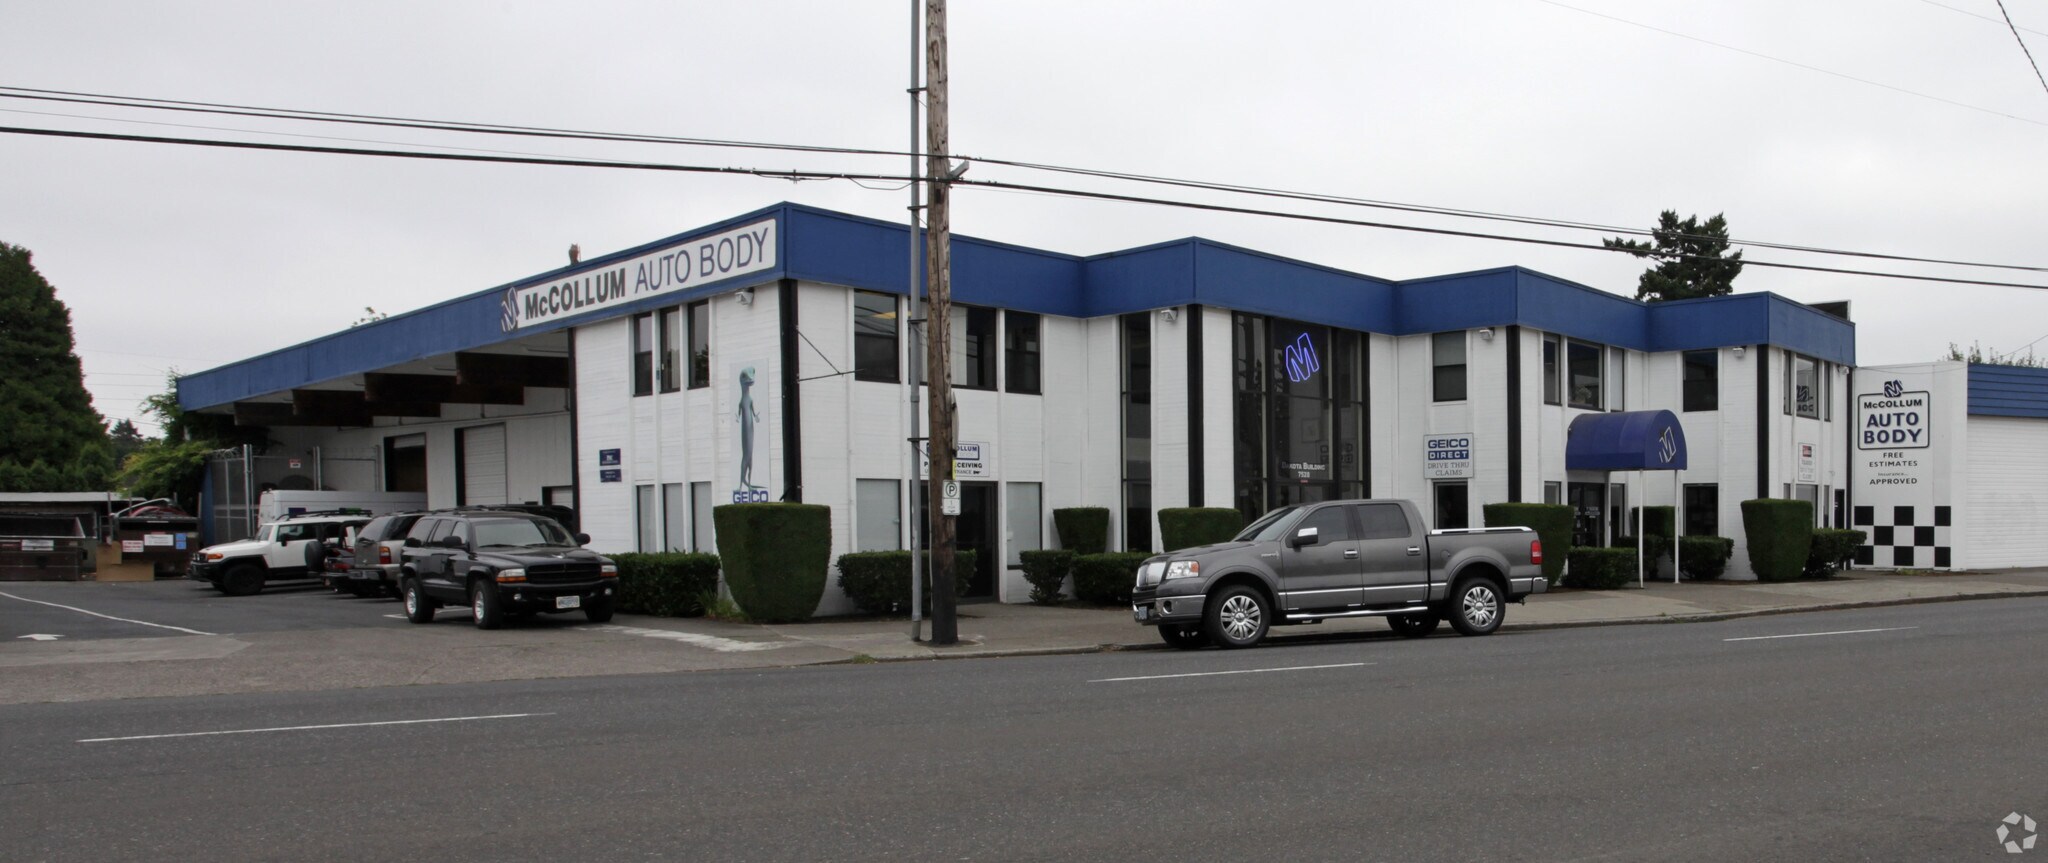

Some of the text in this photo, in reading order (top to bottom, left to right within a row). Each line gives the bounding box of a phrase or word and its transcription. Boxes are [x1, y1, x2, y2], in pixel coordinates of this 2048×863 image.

[525, 227, 769, 320] McCOLLUM AUTO BODY
[1864, 399, 1922, 409] McCOLLUM
[1867, 412, 1919, 428] AUTO
[1864, 429, 1922, 444] BODY
[1428, 438, 1469, 449] GEICO
[1429, 451, 1468, 459] DIRECT
[733, 490, 769, 503] GEICO
